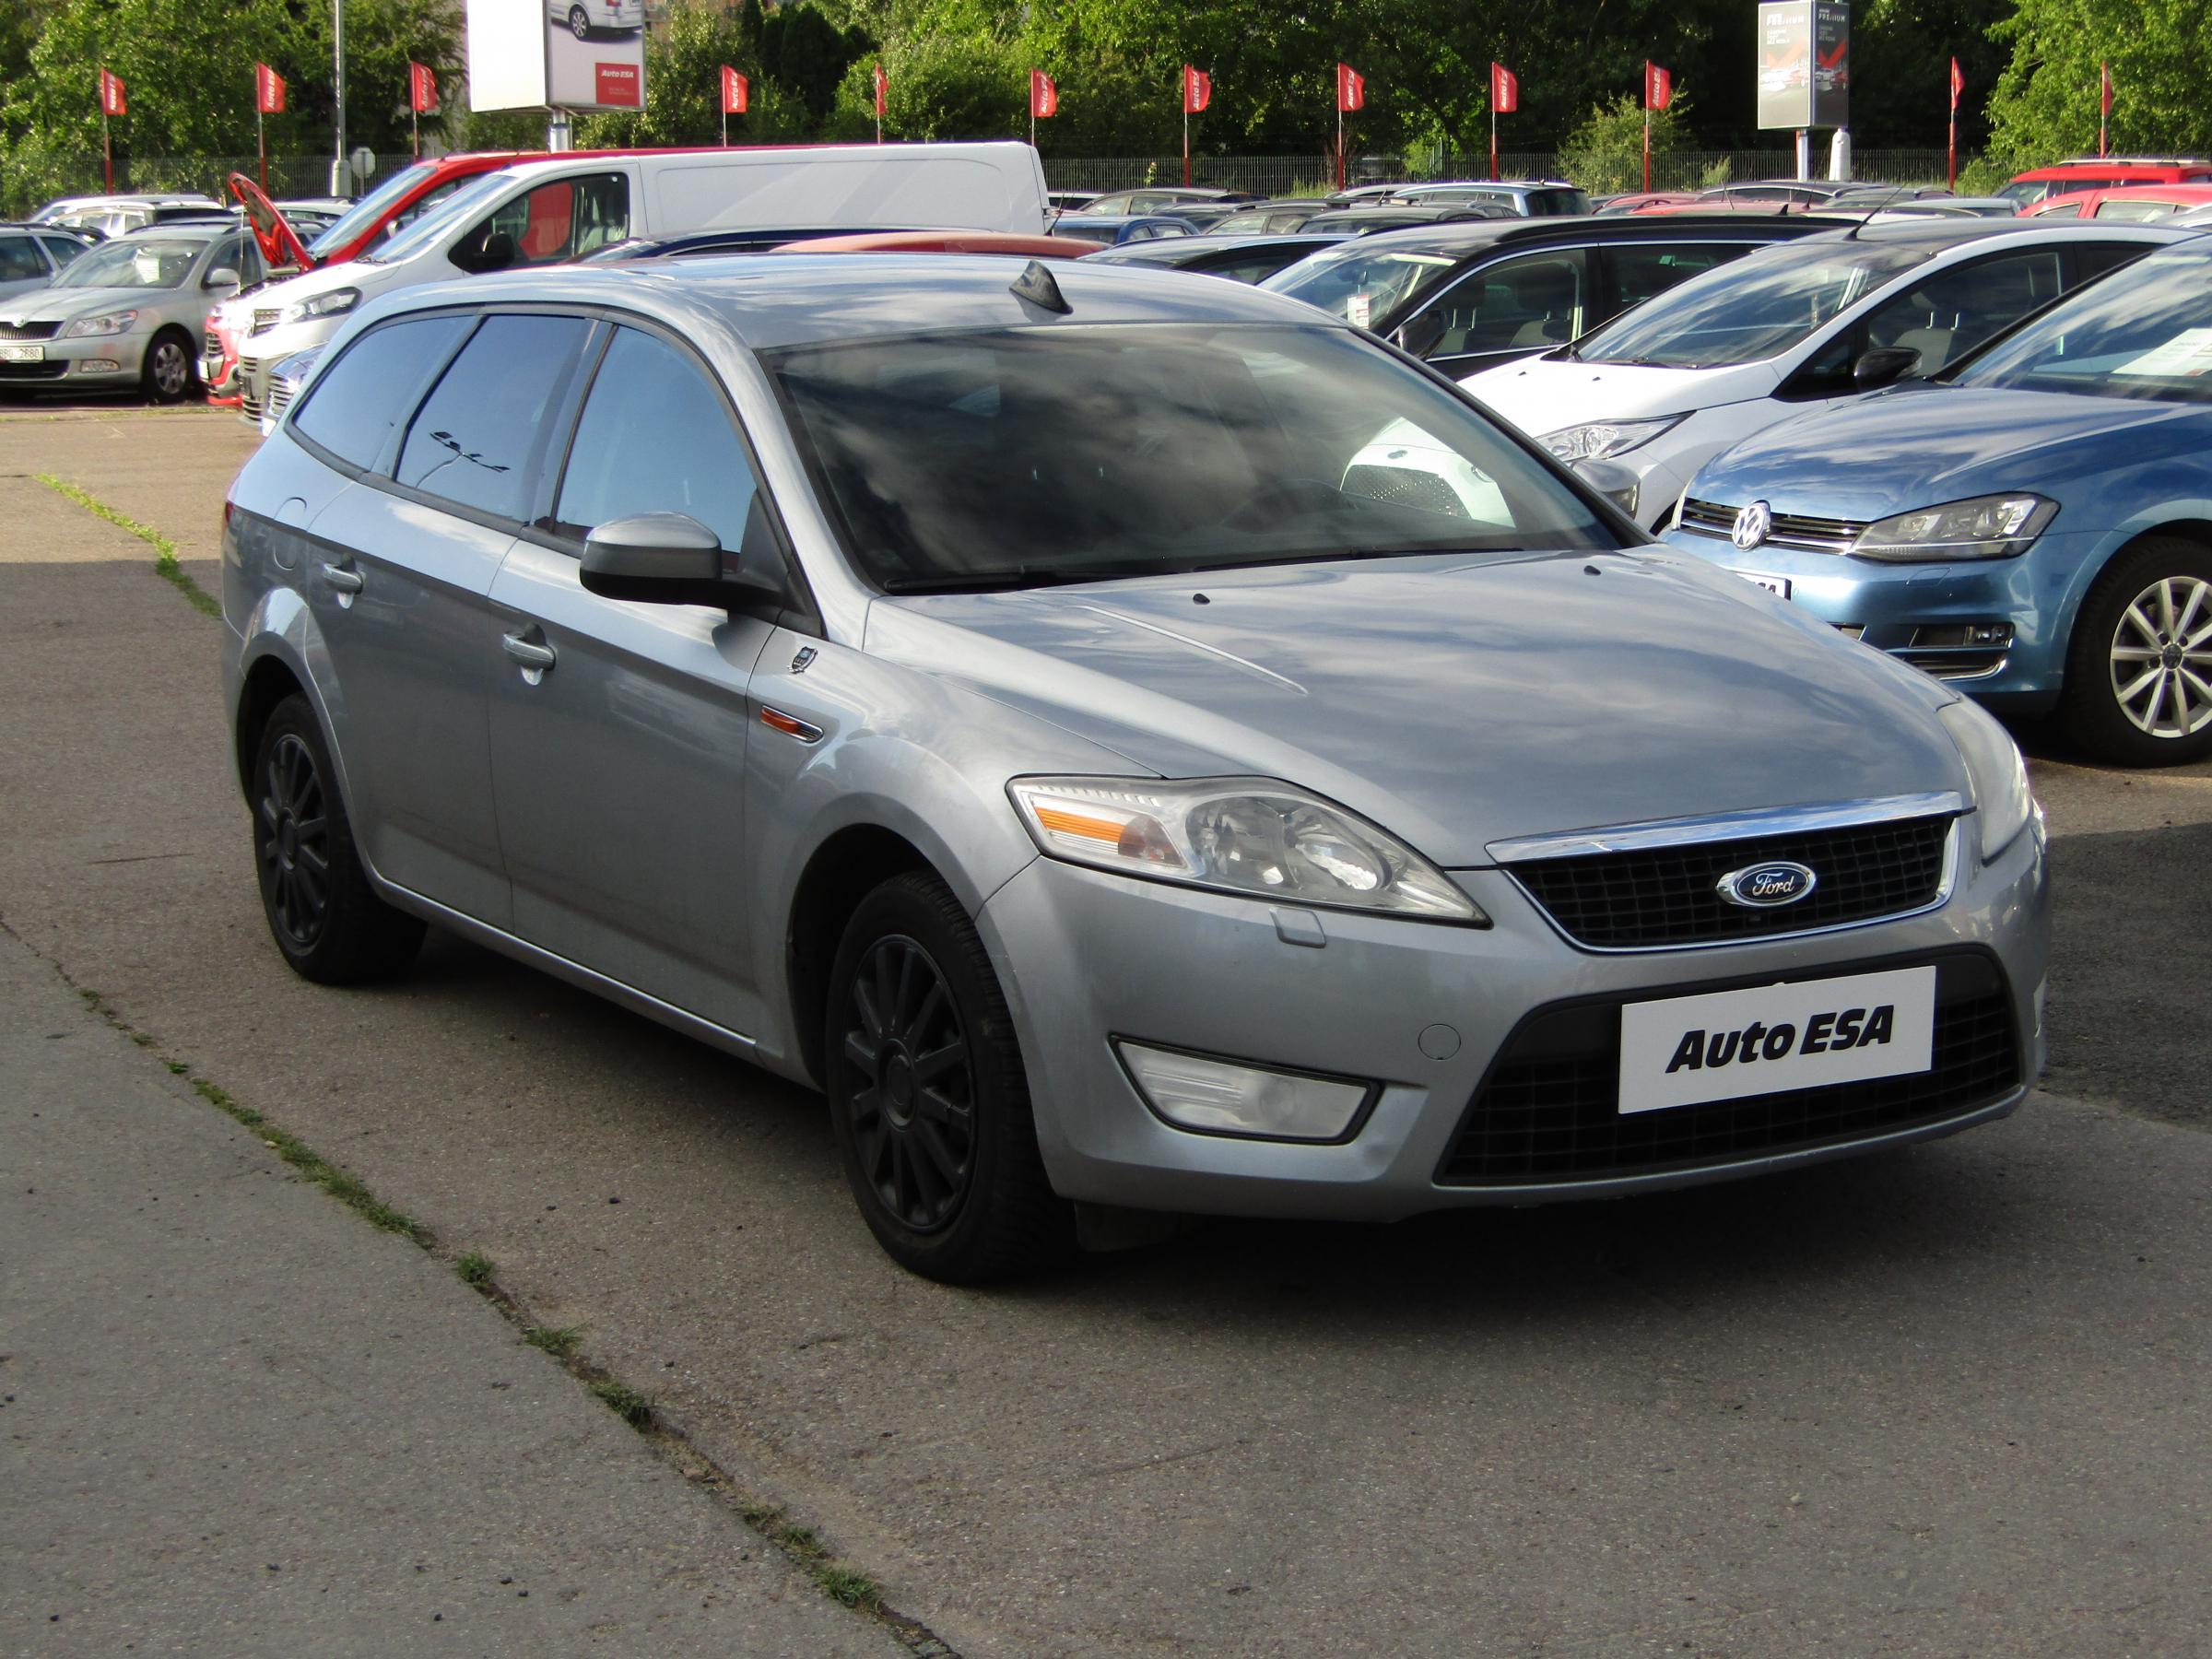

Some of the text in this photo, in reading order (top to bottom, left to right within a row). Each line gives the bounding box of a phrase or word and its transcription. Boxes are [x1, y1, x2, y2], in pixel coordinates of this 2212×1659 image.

[1752, 872, 1795, 896] Ford
[1665, 1005, 1894, 1074] Auto ESA
